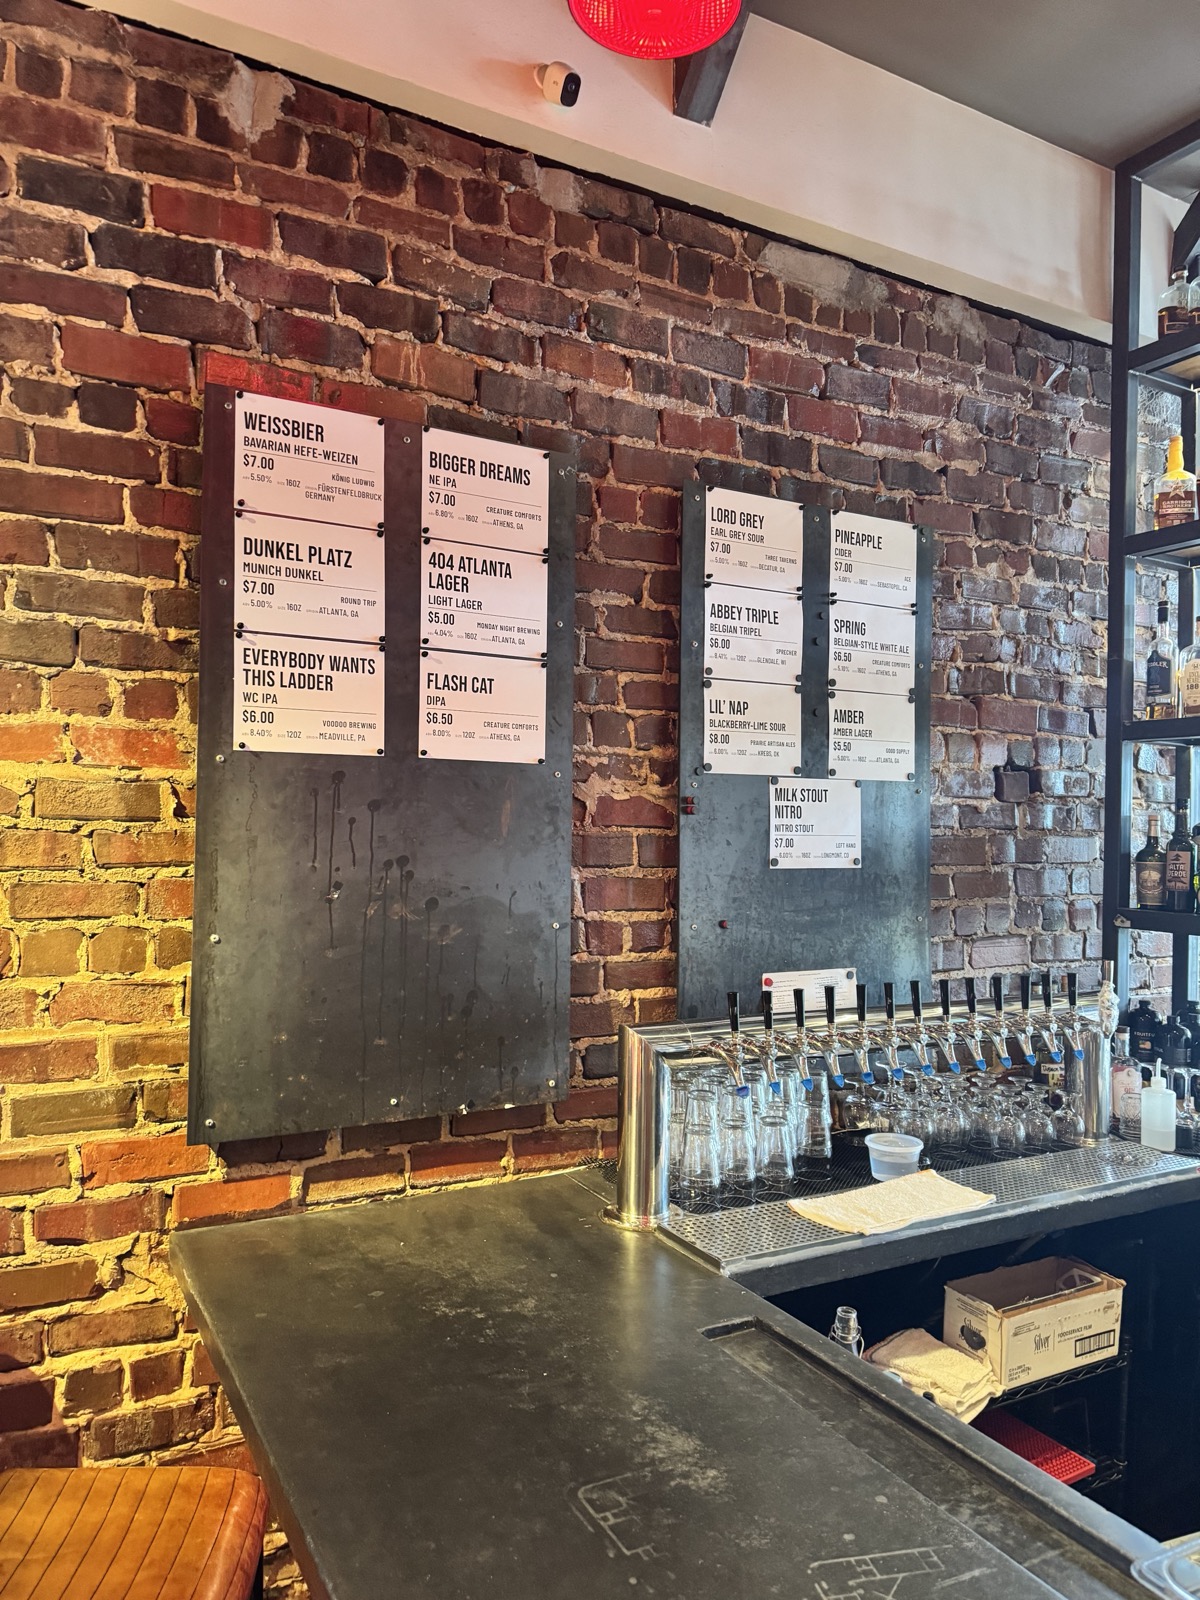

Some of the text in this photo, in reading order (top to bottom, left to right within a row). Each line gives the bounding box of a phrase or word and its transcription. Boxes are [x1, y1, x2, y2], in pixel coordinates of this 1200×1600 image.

[244, 411, 324, 442] WEISSBIER
[244, 436, 358, 465] BAVARIAN HEFE-WEIZEN
[243, 453, 274, 470] $7.00
[430, 451, 531, 486] BIGGER DREAMS
[251, 473, 272, 483] 5.50%
[318, 483, 382, 501] FÜRSTENFELDBRUCK
[332, 473, 375, 487] KÖNIG LUDWIG
[429, 474, 457, 488] NE IPA
[305, 491, 335, 502] GERMANY
[429, 491, 455, 506] $7.00
[486, 506, 541, 521] CREATURE COMFORTS
[711, 507, 764, 529] LORD GREY
[493, 520, 515, 529] ATHENS,
[711, 527, 764, 543] EARL GREY SOUR
[835, 529, 882, 550] PINEAPPLE
[243, 537, 352, 568] DUNKEL PLATZ
[711, 541, 730, 554] $7.00
[835, 548, 852, 558] CIDER
[243, 562, 324, 581] MUNICH DUNKEL
[429, 552, 512, 579] 404 ATLANTA
[835, 561, 852, 573] $7.00
[243, 580, 274, 595] $7.00
[429, 572, 469, 593] LAGER
[251, 599, 272, 609] 5.00%
[319, 607, 349, 617] ATLANTA,
[351, 610, 358, 618] GA
[341, 597, 376, 607] ROUND TRIP
[428, 594, 482, 610] LIGHT LAGER
[428, 611, 454, 625] $5.00
[710, 603, 779, 625] ABBEY TRIPLE
[477, 622, 498, 630] MONDAY
[517, 627, 540, 635] BREWING
[710, 623, 762, 637] BELGIAN TRIPEL
[834, 619, 866, 635] SPRING
[434, 629, 453, 638] 4.04%
[492, 636, 517, 645] ATLANTA,
[710, 638, 730, 649] $6.00
[834, 638, 909, 654] BELGIAN-STYLE WHITE ALE
[243, 648, 375, 674] EVERYBODY WANTS
[834, 651, 851, 662] $6.50
[243, 669, 333, 691] THIS LADDER
[427, 673, 494, 694] FLASH CAT
[243, 692, 278, 704] WC IPA
[427, 696, 446, 706] DIPA
[729, 701, 748, 715] NAP
[243, 710, 274, 724] $6.00
[426, 712, 453, 725] $6.50
[834, 709, 864, 724] AMBER
[323, 720, 347, 728] VOODOO
[484, 721, 539, 731] CREATURE COMFORTS
[709, 719, 786, 731] BLACKBERRY-LIME SOUR
[250, 729, 272, 737] 8.40%
[319, 733, 356, 742] MEADVILLE,
[358, 734, 365, 742] PA
[433, 729, 451, 737] 8.00%
[490, 733, 512, 741] ATHENS,
[709, 733, 729, 744] $8.00
[833, 728, 872, 737] AMBER LAGER
[833, 741, 851, 751] $5.50
[775, 788, 828, 802] MILK STOUT
[775, 805, 802, 819] NITRO
[775, 824, 793, 832] NITRO
[775, 838, 794, 848] $7.00
[1058, 1326, 1083, 1338] FOODSERVICE
[1034, 1332, 1051, 1352] Silver
